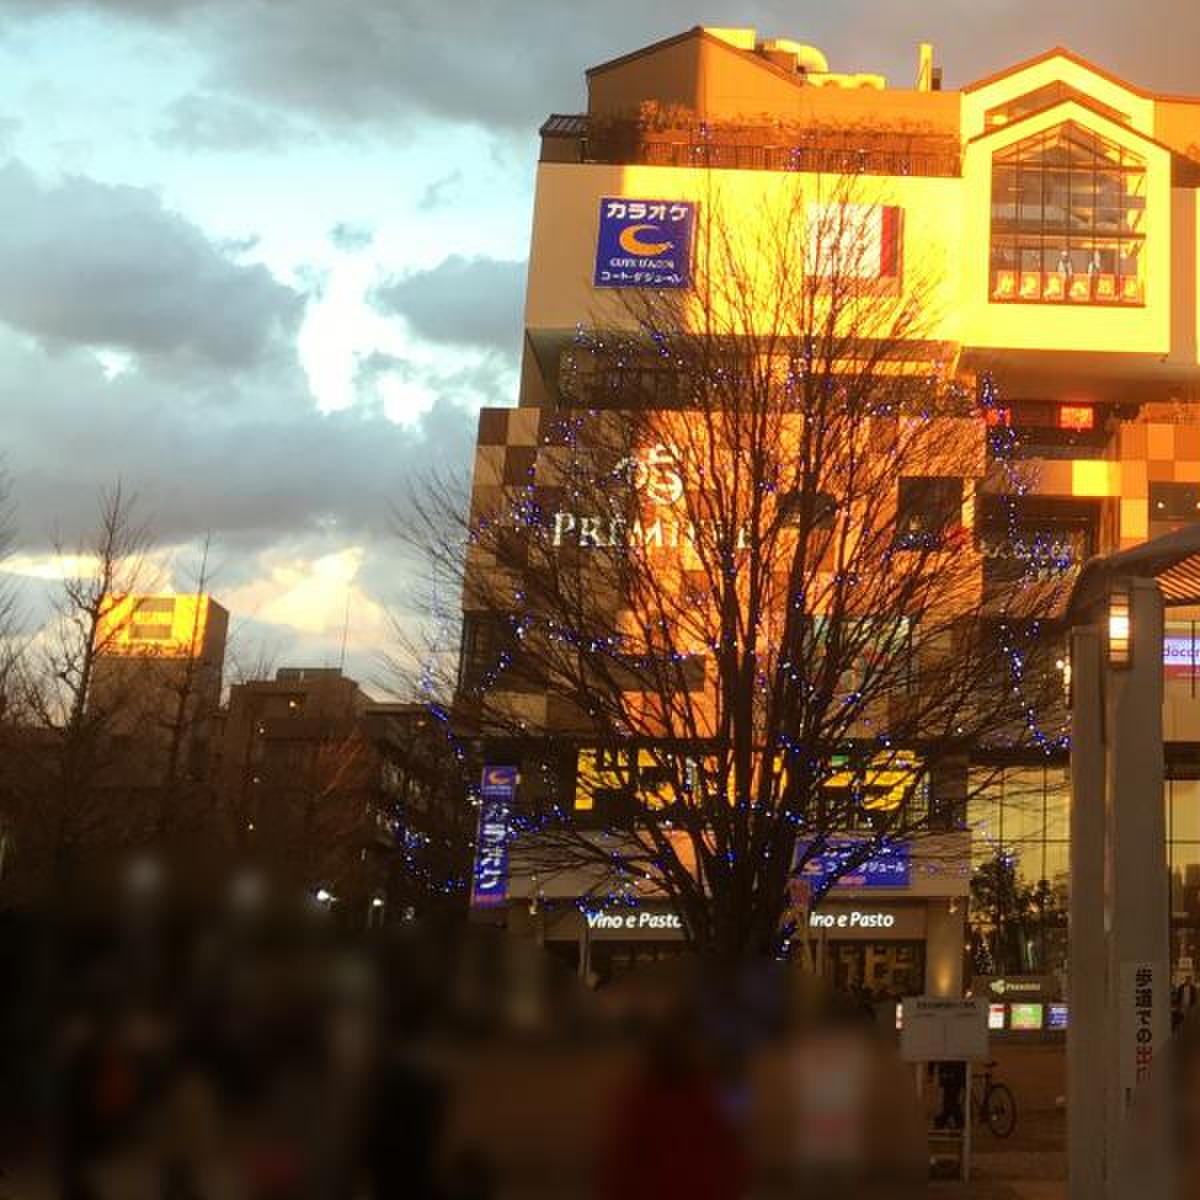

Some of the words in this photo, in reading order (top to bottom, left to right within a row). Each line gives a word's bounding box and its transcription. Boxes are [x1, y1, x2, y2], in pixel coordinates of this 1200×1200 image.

[606, 202, 689, 221] カラオケ
[585, 910, 623, 929] Vino
[625, 914, 637, 929] e
[808, 911, 835, 928] ino
[836, 914, 848, 928] e
[849, 911, 895, 928] Pasto
